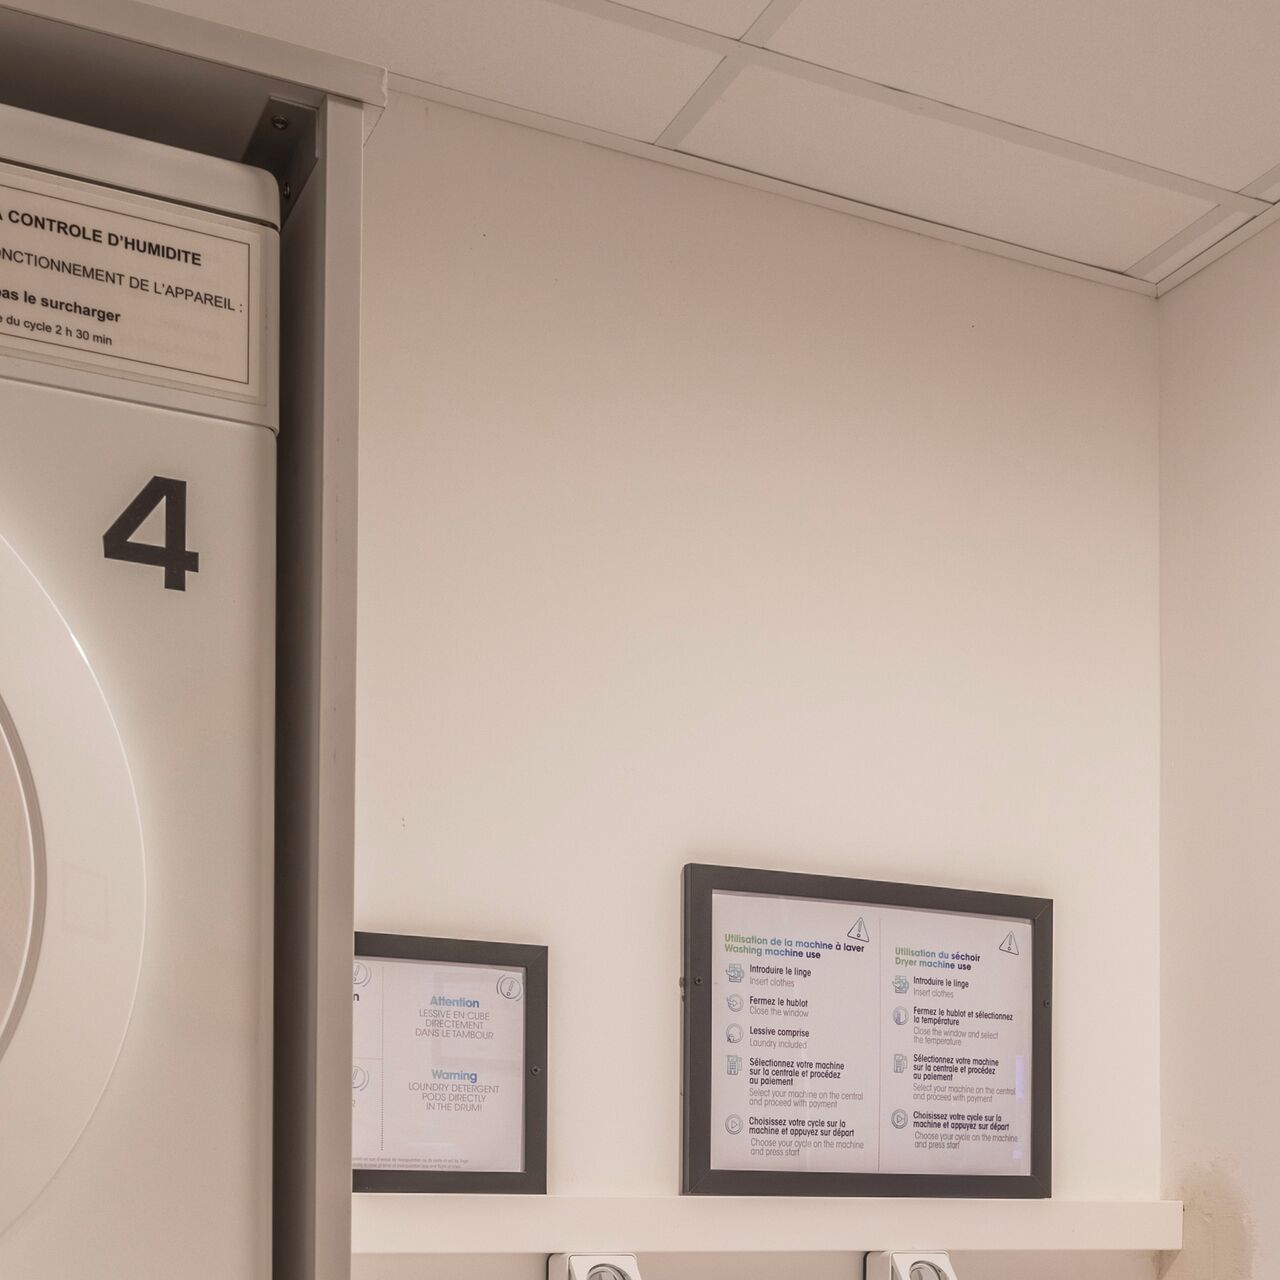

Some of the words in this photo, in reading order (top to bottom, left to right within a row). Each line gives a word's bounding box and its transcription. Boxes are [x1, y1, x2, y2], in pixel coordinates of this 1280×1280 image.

[8, 210, 103, 243] CONTROLE
[107, 233, 202, 267] D'HUMIDITE
[129, 275, 150, 292] DE
[153, 281, 236, 312] L'APPAREIL
[23, 290, 37, 305] le
[40, 294, 121, 324] surcharger
[6, 313, 20, 327] du
[23, 318, 52, 335] cycle
[55, 324, 62, 334] 2
[65, 325, 73, 337] h
[75, 328, 90, 340] 30
[92, 331, 112, 346] min
[103, 475, 199, 592] 4
[724, 934, 768, 945] Utilisation
[770, 937, 782, 946] de
[785, 938, 792, 946] la
[795, 939, 833, 950] machine
[836, 942, 841, 950] à
[844, 943, 864, 952] laver
[725, 944, 762, 956] Washing
[765, 947, 803, 958] machine
[895, 947, 936, 958] Utilisation
[938, 951, 949, 959] du
[951, 952, 980, 962] séchoir
[750, 964, 783, 975] Introduire
[786, 966, 792, 976] le
[794, 967, 811, 978] linge
[895, 957, 917, 967] Dryer
[919, 959, 955, 970] machine
[957, 963, 971, 971] use
[430, 995, 480, 1009] Attention
[419, 1009, 451, 1019] LESSIVE
[453, 1010, 465, 1020] EN
[467, 1011, 490, 1021] CUBE
[914, 1006, 937, 1016] Fermez
[939, 1008, 944, 1016] le
[946, 1008, 966, 1018] hublot
[975, 1010, 1013, 1021] sélectionnez
[425, 1019, 484, 1030] DIRECTEMENT
[415, 1028, 440, 1038] DANS
[442, 1029, 451, 1038] LE
[452, 1029, 494, 1040] TAMBOUR
[431, 1069, 478, 1084] Warning
[408, 1082, 449, 1092] LOUNDRY
[452, 1084, 500, 1094] DETERGENT
[422, 1092, 447, 1102] PODS
[449, 1093, 486, 1103] DIRECTLY
